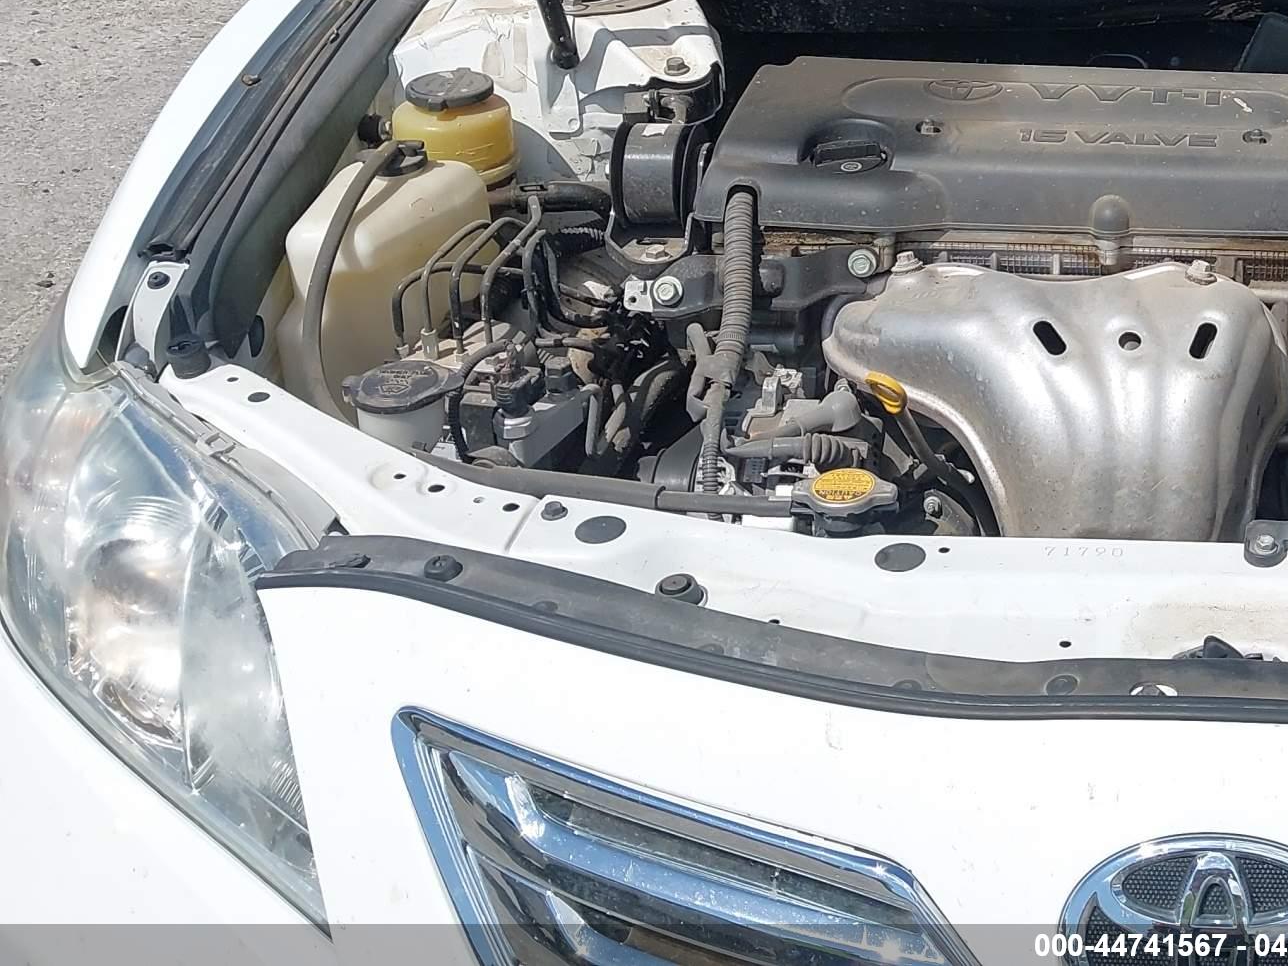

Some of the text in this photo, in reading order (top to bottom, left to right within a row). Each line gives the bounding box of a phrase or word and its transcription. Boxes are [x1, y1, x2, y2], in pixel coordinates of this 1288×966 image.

[1019, 128, 1218, 148] 16 VALVE
[1044, 545, 1124, 557] 71790
